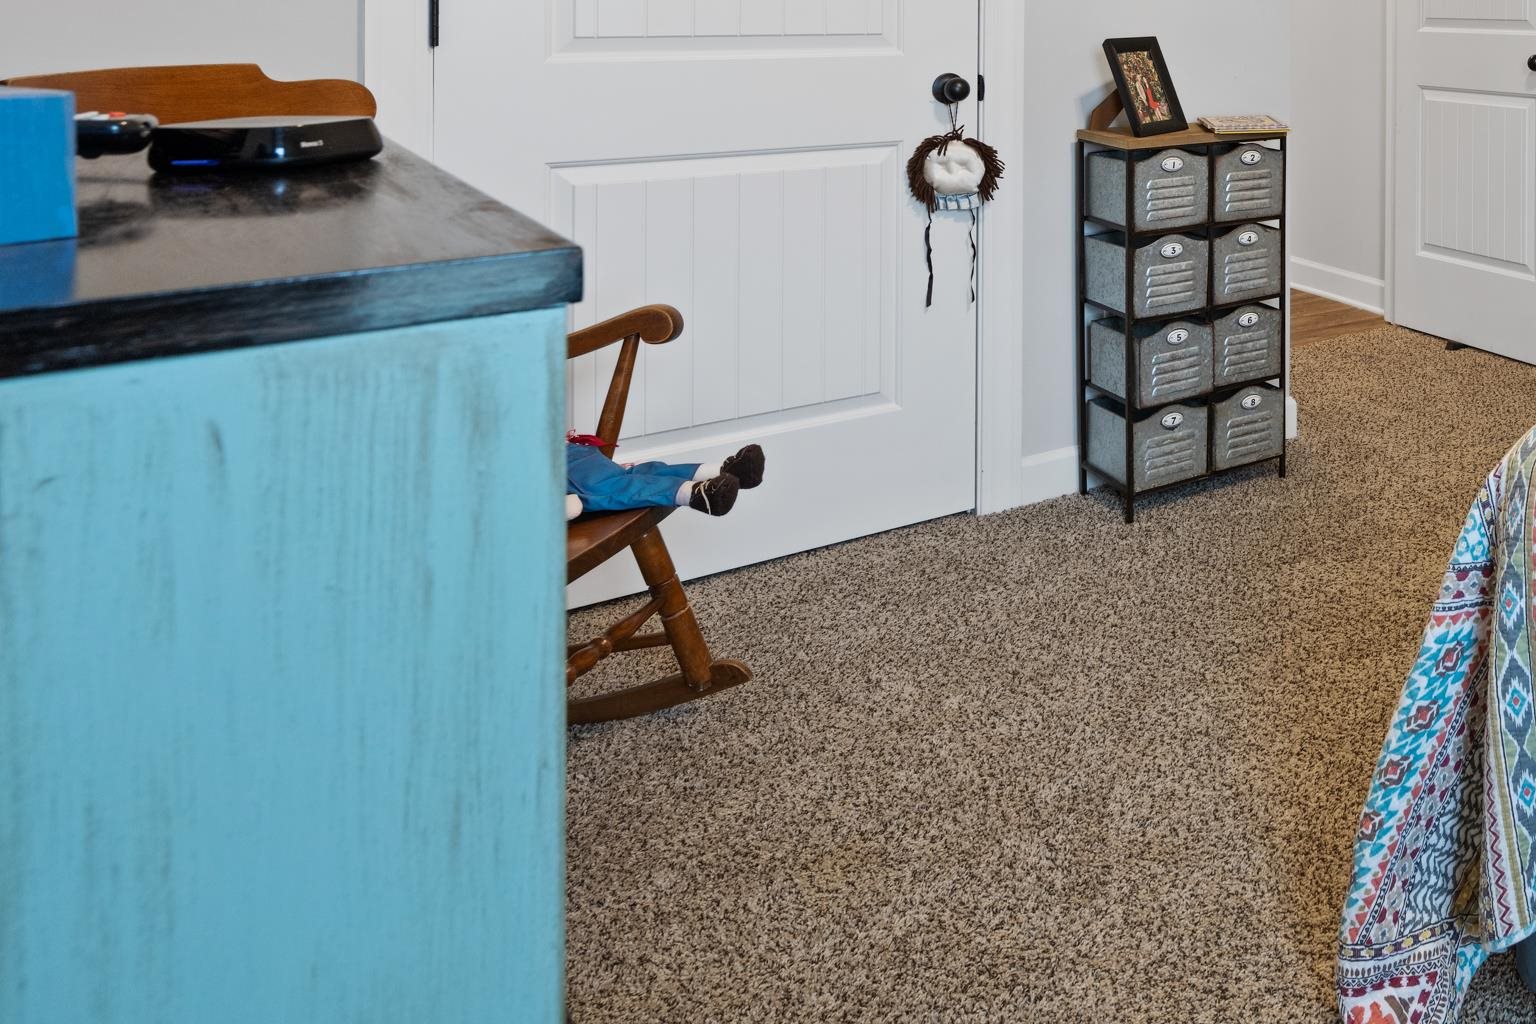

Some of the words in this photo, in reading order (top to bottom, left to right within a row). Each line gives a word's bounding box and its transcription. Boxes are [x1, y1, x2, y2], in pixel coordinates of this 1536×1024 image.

[1250, 154, 1255, 162] 2
[1171, 246, 1176, 255] 3
[1247, 316, 1253, 324] 6
[1176, 333, 1182, 341] 5
[1250, 398, 1256, 406] 8
[1171, 416, 1177, 425] 7
